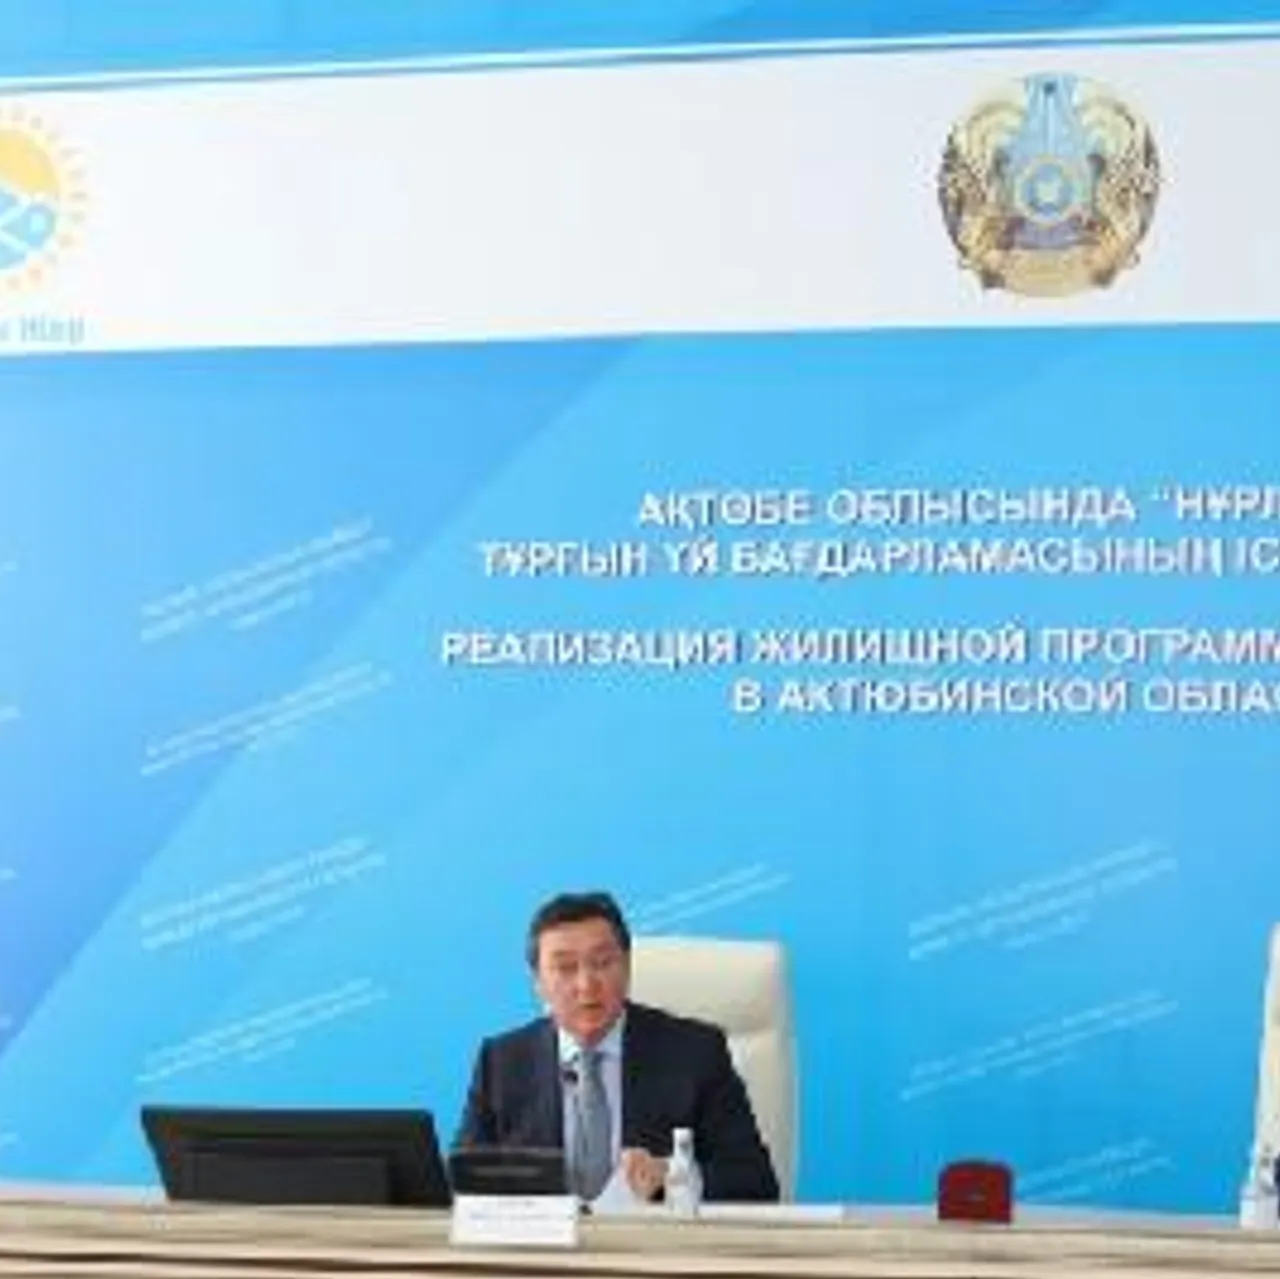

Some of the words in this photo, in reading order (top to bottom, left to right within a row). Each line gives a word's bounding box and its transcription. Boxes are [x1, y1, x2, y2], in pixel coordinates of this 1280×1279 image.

[825, 487, 1137, 530] ОБЛЫСЫНДА
[440, 628, 736, 670] РЕАЛИЗАЦИЯ
[732, 677, 763, 715] В
[778, 671, 1129, 714] АКТЮБИНСКОЙ
